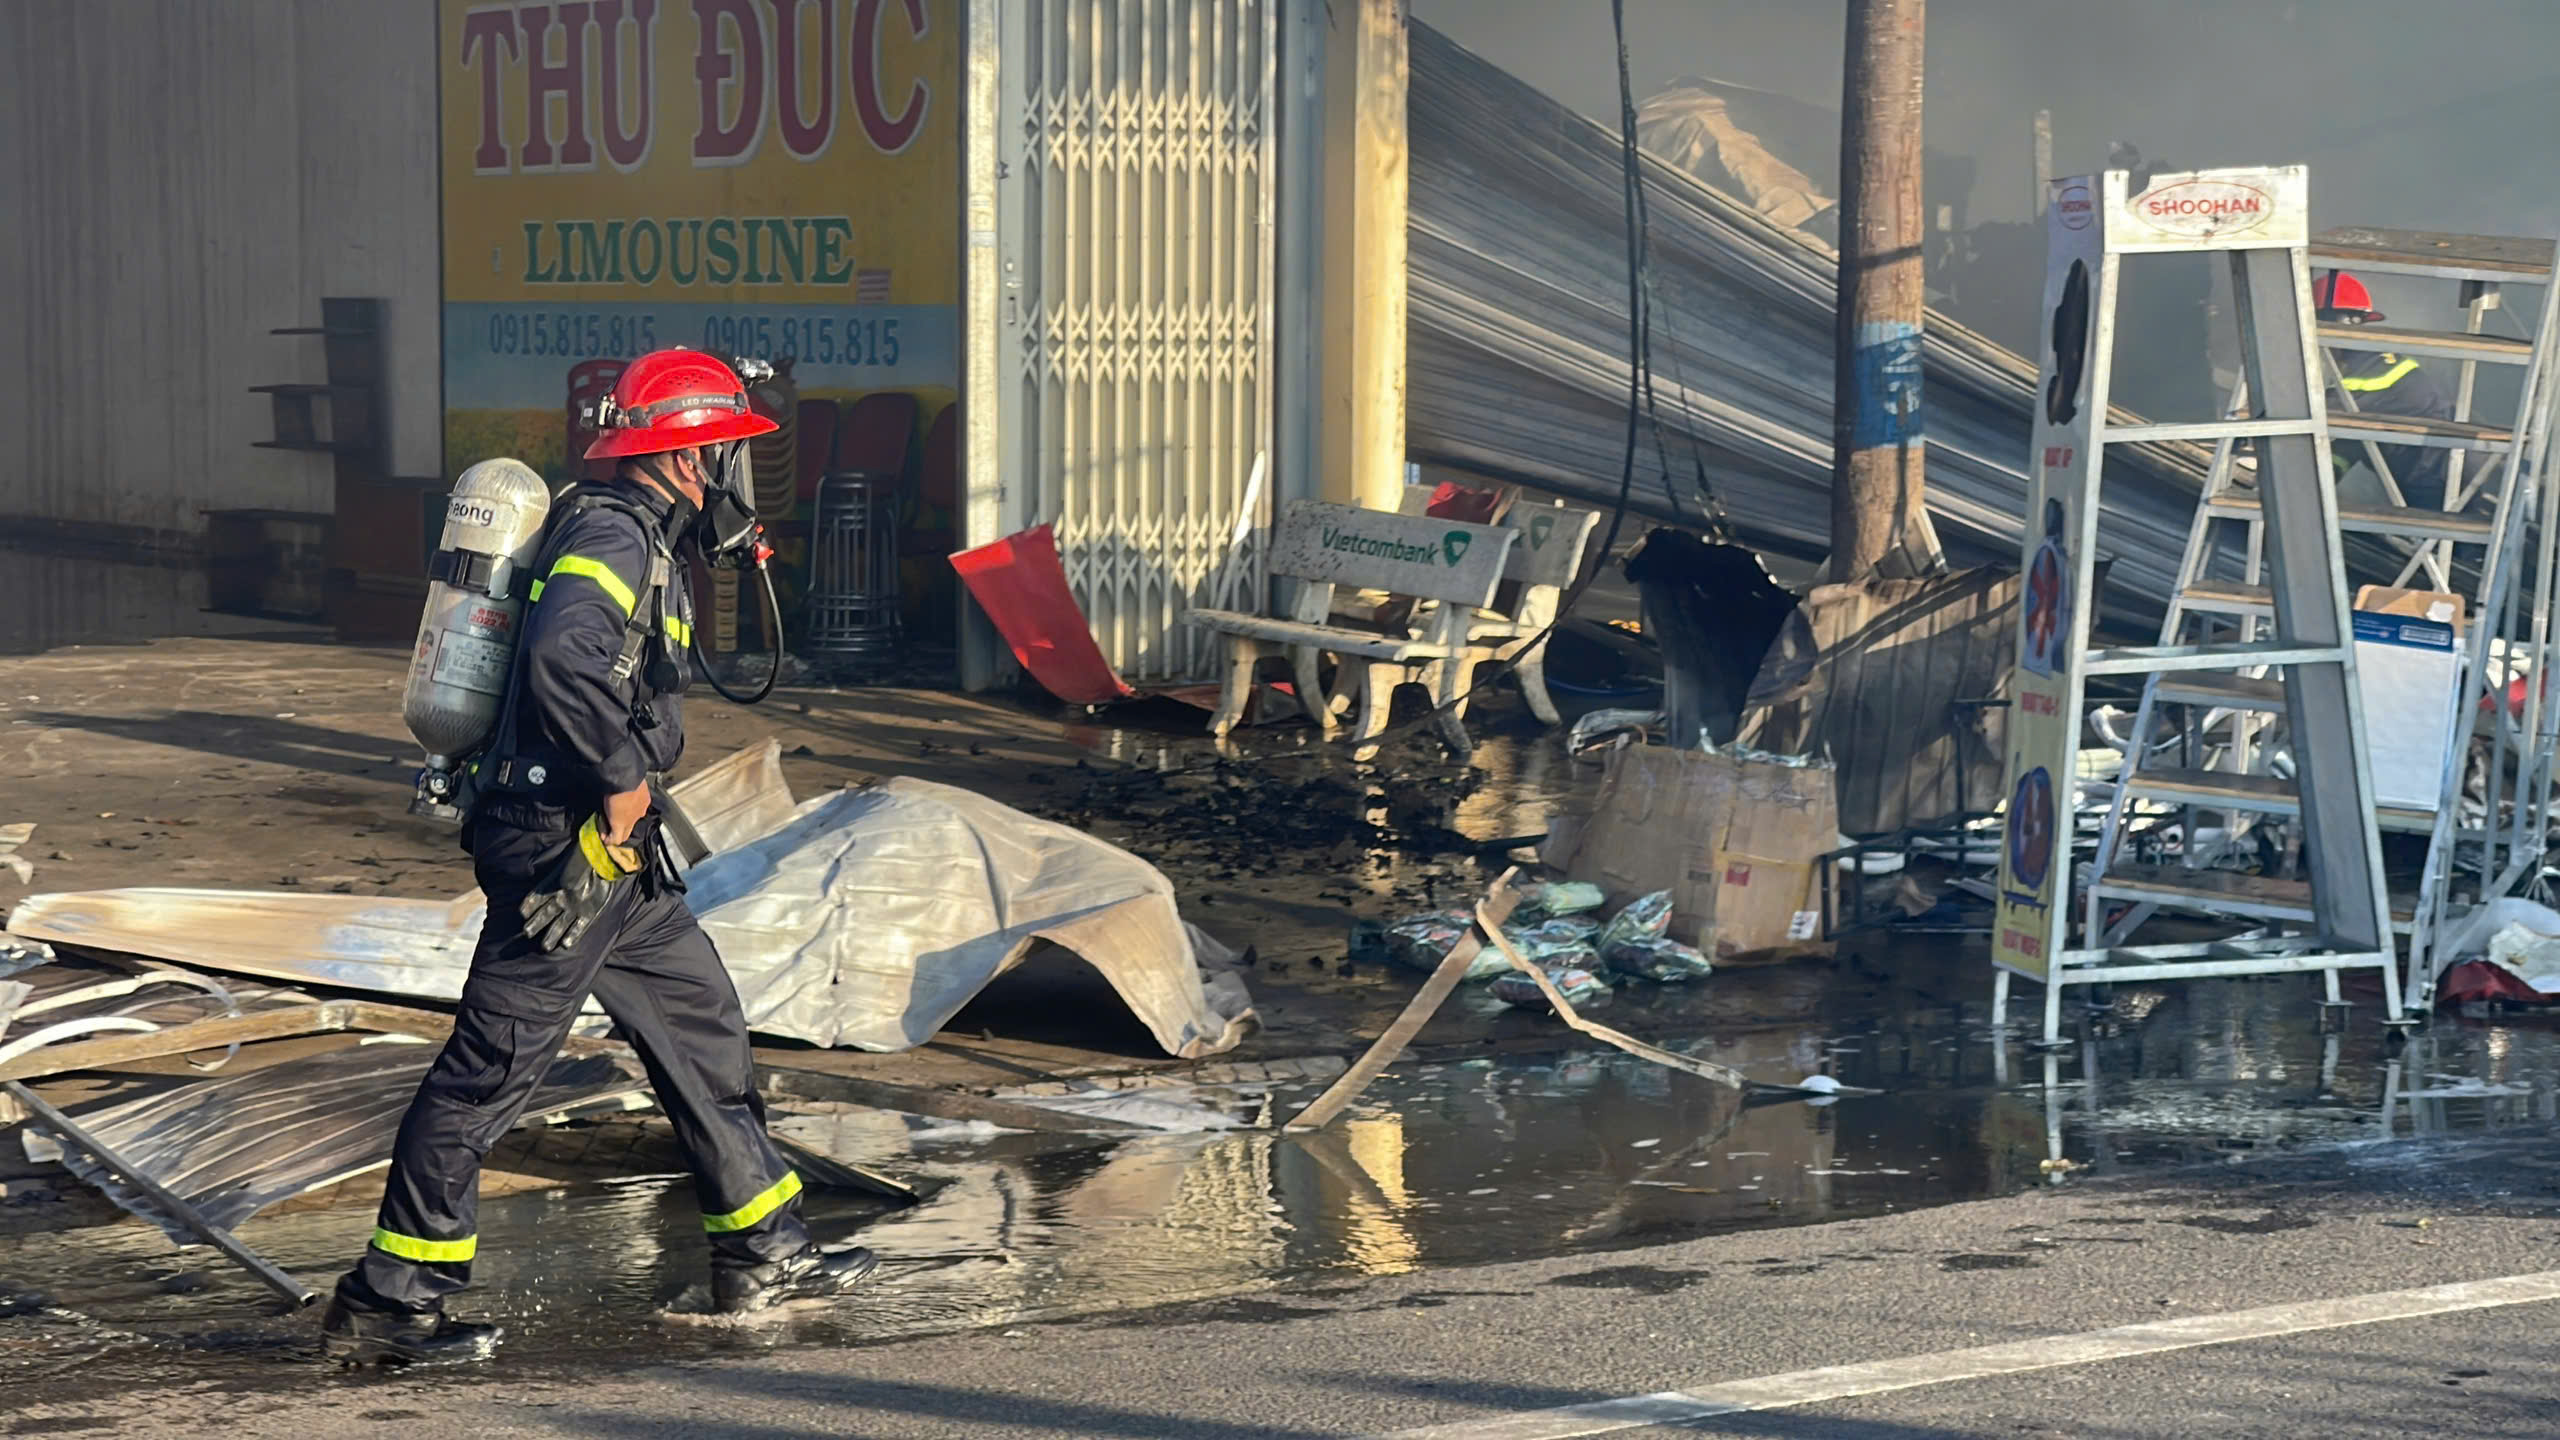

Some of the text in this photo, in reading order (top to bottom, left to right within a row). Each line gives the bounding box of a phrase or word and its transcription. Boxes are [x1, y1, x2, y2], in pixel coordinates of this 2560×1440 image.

[2149, 197, 2261, 216] SHOOHAN
[523, 217, 855, 285] LIMOUSINE
[489, 312, 900, 367] 0915.815.815 0905.815.815
[682, 398, 699, 407] LED
[1322, 527, 1440, 565] Vietcombank
